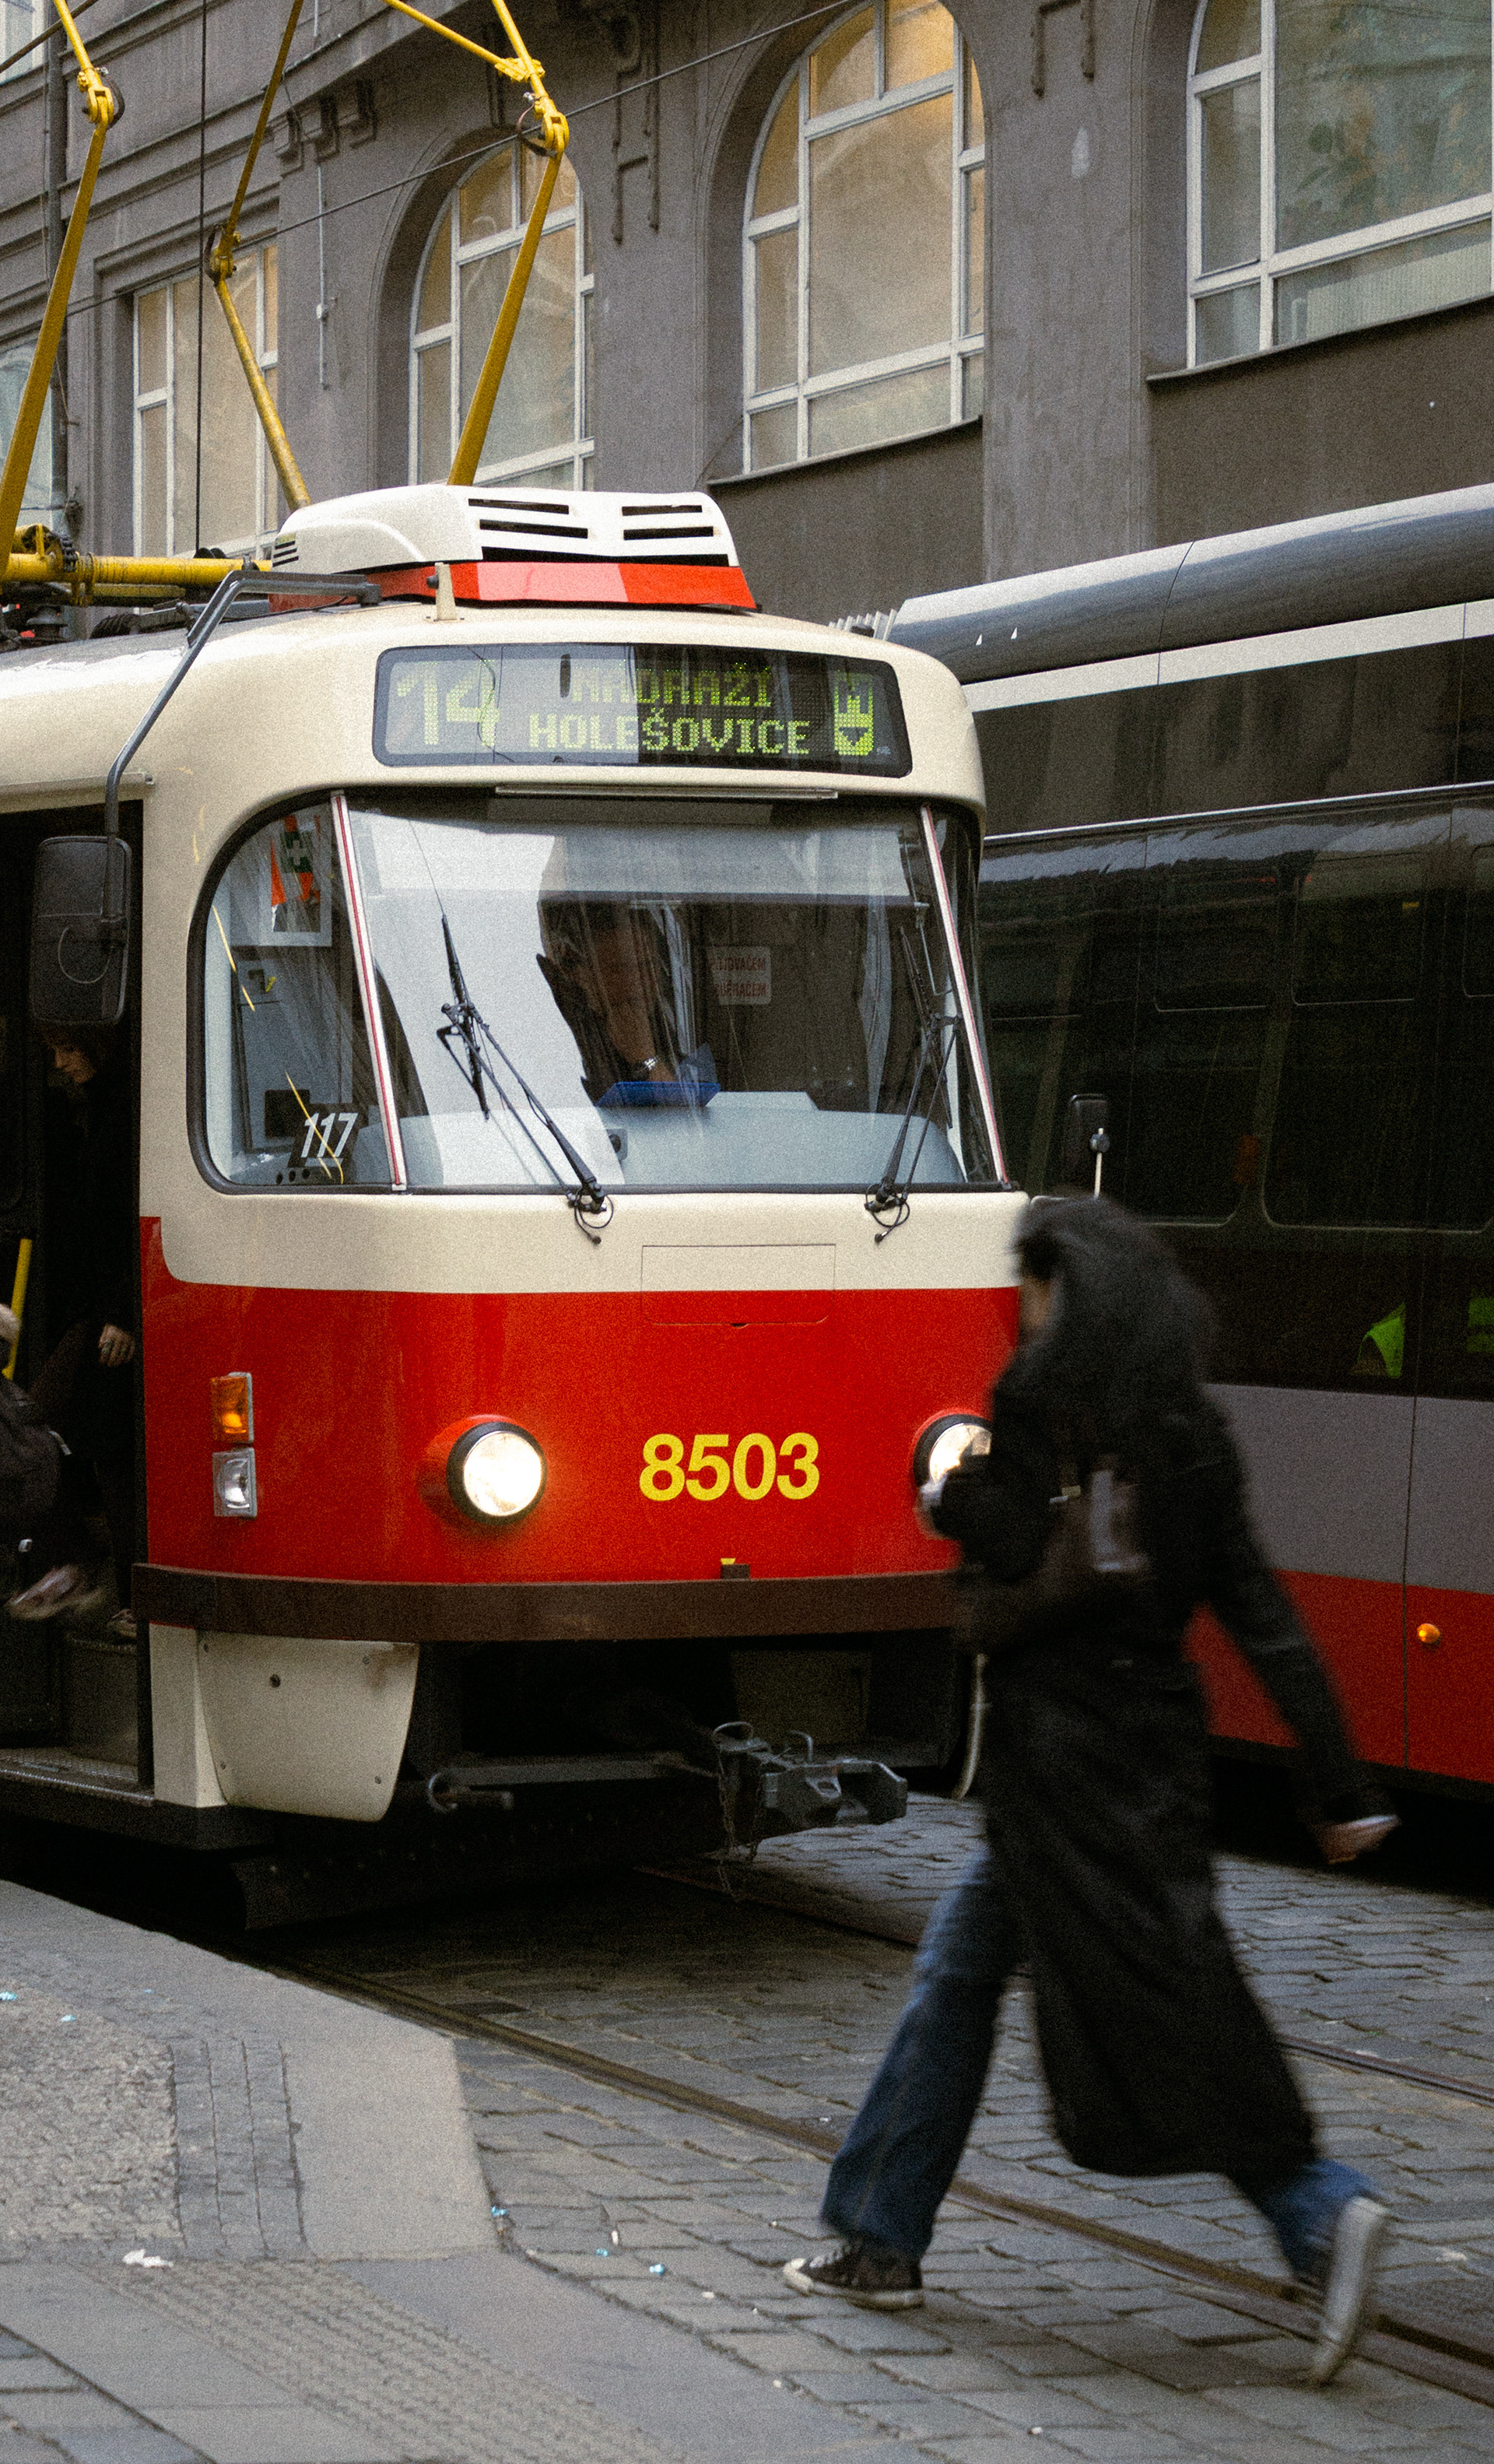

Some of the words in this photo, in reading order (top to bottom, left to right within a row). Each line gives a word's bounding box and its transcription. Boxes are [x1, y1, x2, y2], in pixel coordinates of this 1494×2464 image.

[397, 659, 500, 746] 14
[529, 707, 811, 754] HOLEŠOVICE
[301, 1113, 359, 1158] 117
[639, 1432, 820, 1501] 8503
